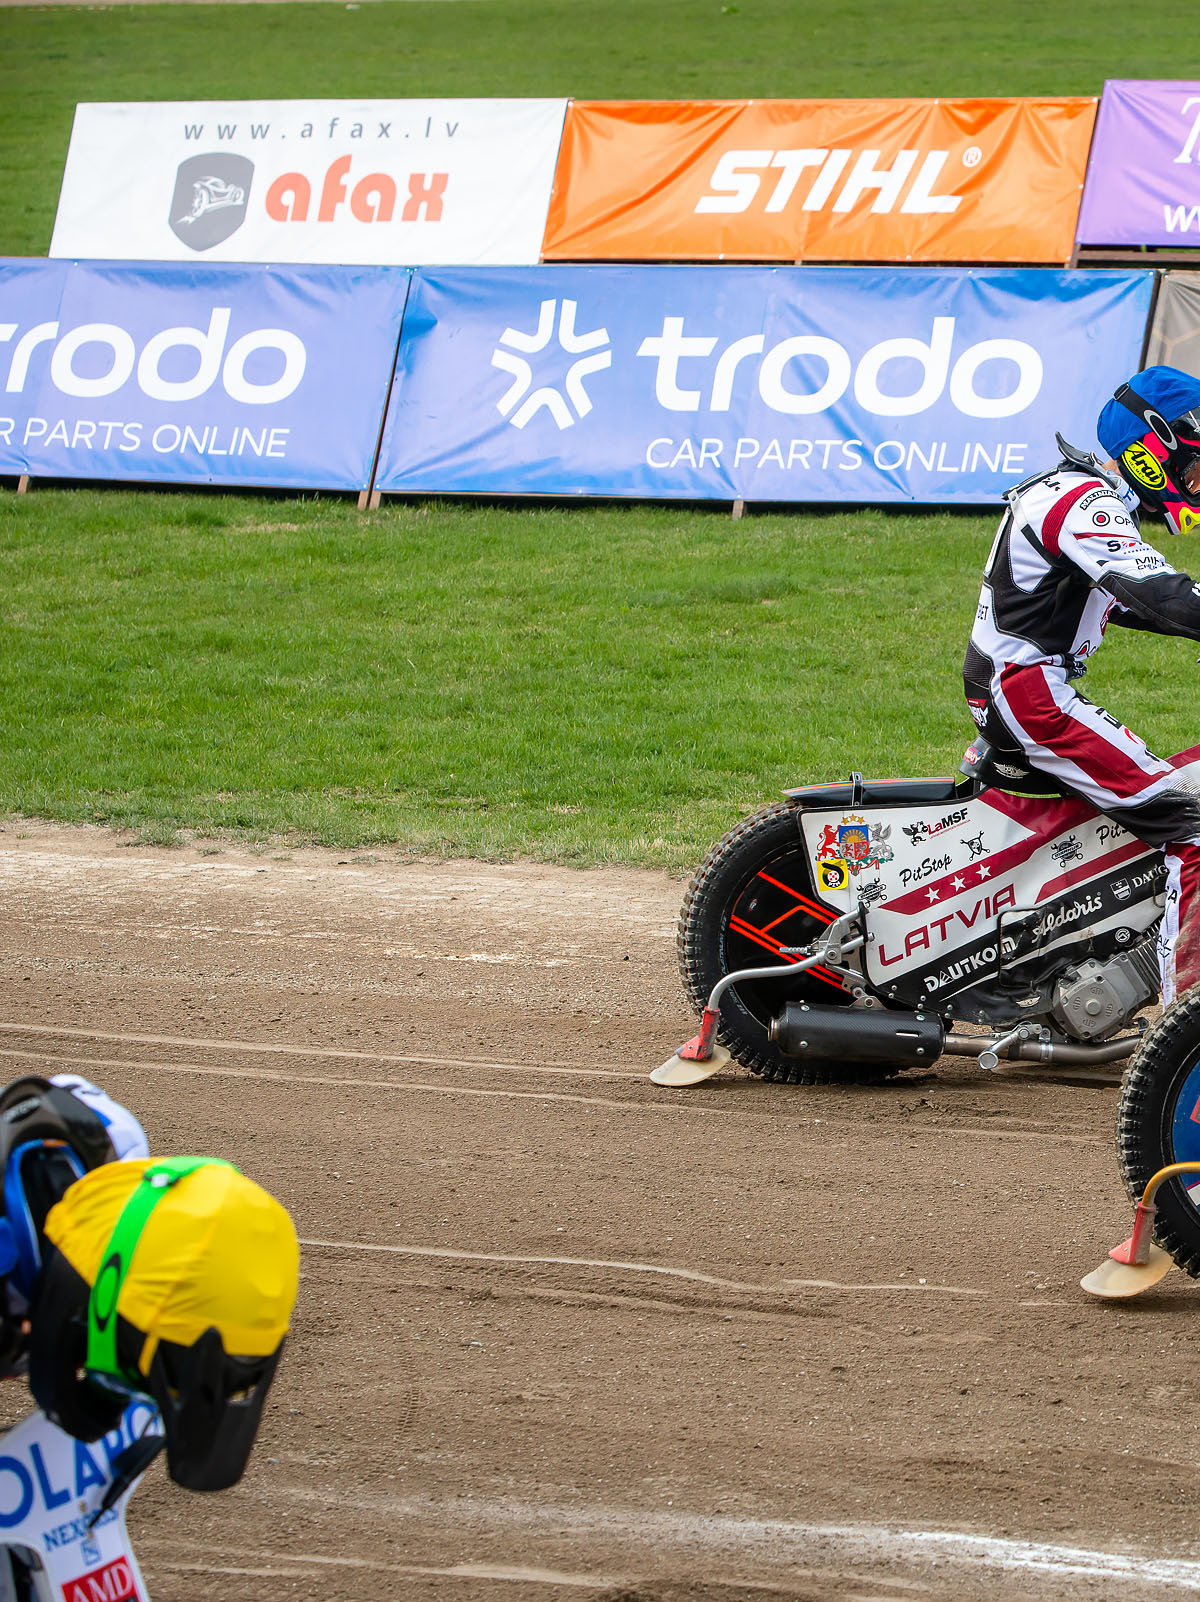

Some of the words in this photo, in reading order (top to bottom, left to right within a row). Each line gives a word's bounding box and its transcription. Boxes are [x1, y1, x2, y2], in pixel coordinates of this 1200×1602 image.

[264, 153, 450, 224] afax
[0, 307, 307, 405] rodo
[637, 316, 1044, 419] trodo
[23, 417, 143, 451] PARTS
[152, 423, 290, 458] ONLINE
[645, 436, 721, 469] CAR
[733, 438, 863, 470] PARTS
[872, 439, 1029, 474] ONLINE
[1127, 450, 1163, 482] Arai
[928, 808, 969, 836] LaMSF
[899, 854, 953, 887] PitStop
[1131, 864, 1170, 889] DAUG
[879, 883, 1017, 967] LATVIA
[1032, 894, 1102, 944] Aldaris
[0, 1400, 158, 1529] OLARO
